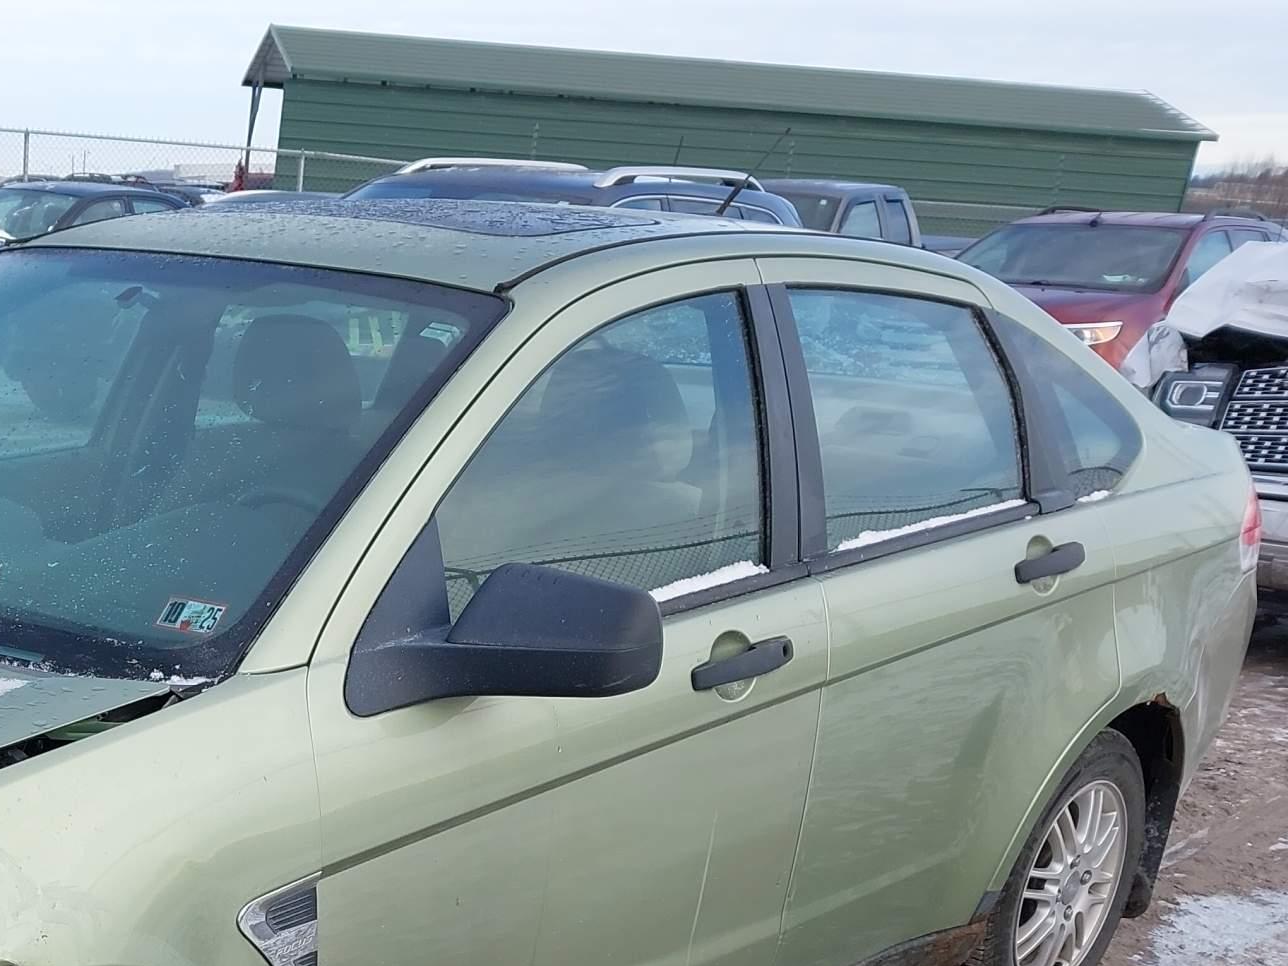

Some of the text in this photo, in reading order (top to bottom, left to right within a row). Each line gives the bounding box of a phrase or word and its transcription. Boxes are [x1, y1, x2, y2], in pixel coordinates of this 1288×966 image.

[162, 601, 223, 631] 10 25
[275, 934, 315, 959] FOCUS
